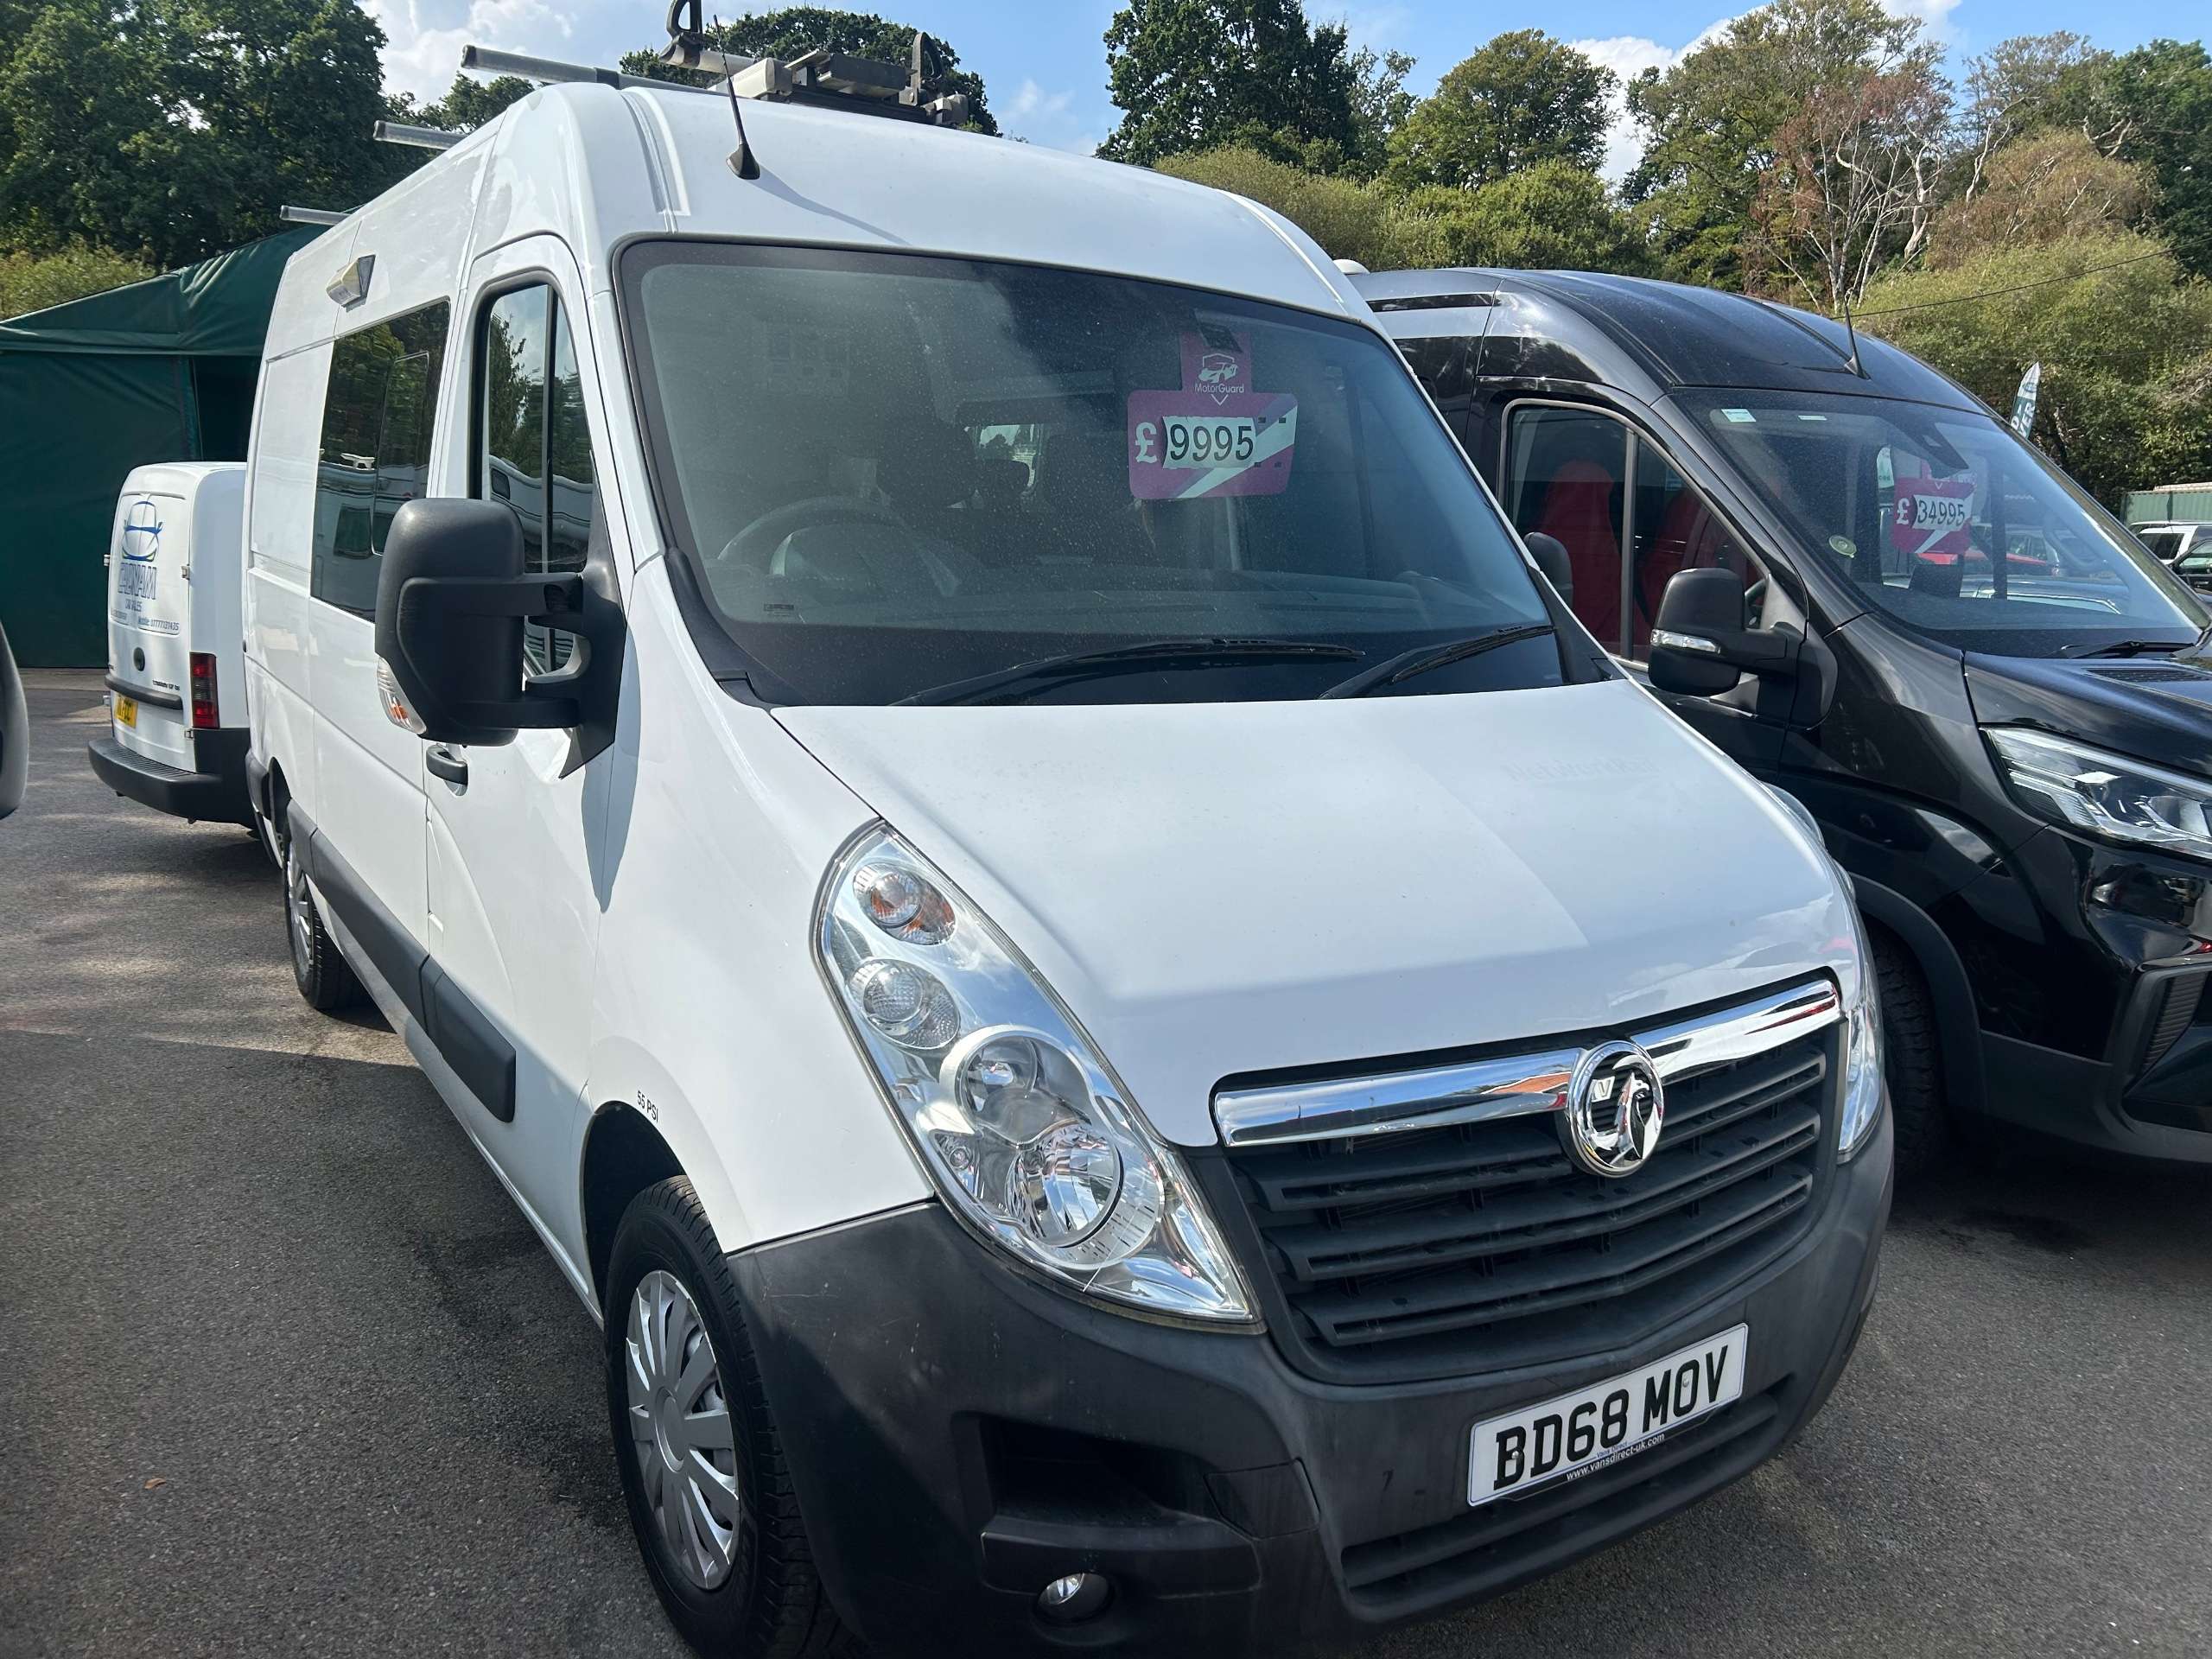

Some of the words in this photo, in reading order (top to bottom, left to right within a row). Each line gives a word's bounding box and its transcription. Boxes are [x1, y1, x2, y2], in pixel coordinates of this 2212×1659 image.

[1194, 383, 1244, 393] MotorGuard
[637, 1090, 645, 1109] 55
[646, 1099, 658, 1123] PSI
[1493, 1389, 1629, 1491] BD68
[1643, 1344, 1728, 1433] MOV
[1566, 1433, 1665, 1481] www.vansdirect-uk.com
